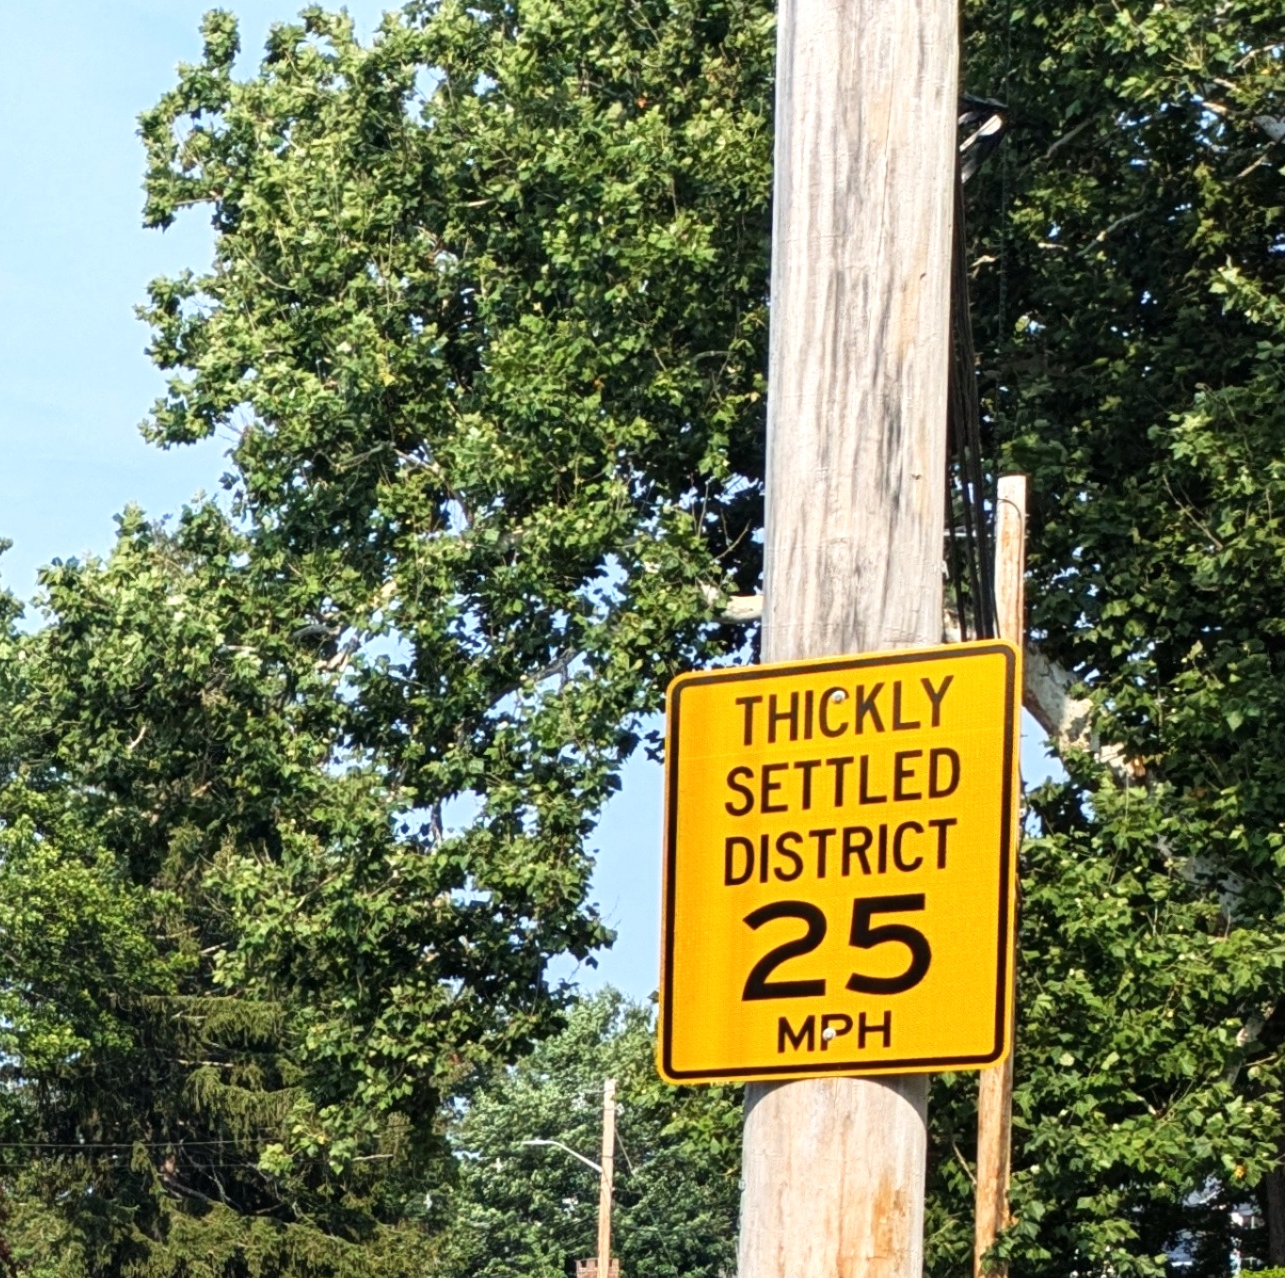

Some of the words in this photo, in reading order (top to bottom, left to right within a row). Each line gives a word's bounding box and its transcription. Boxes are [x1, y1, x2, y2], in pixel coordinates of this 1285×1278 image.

[736, 675, 955, 746] THICKLY
[724, 747, 961, 818] SETTLED
[723, 818, 958, 887] DISTRICT
[741, 893, 932, 1001] 25
[777, 1010, 892, 1054] MPH
